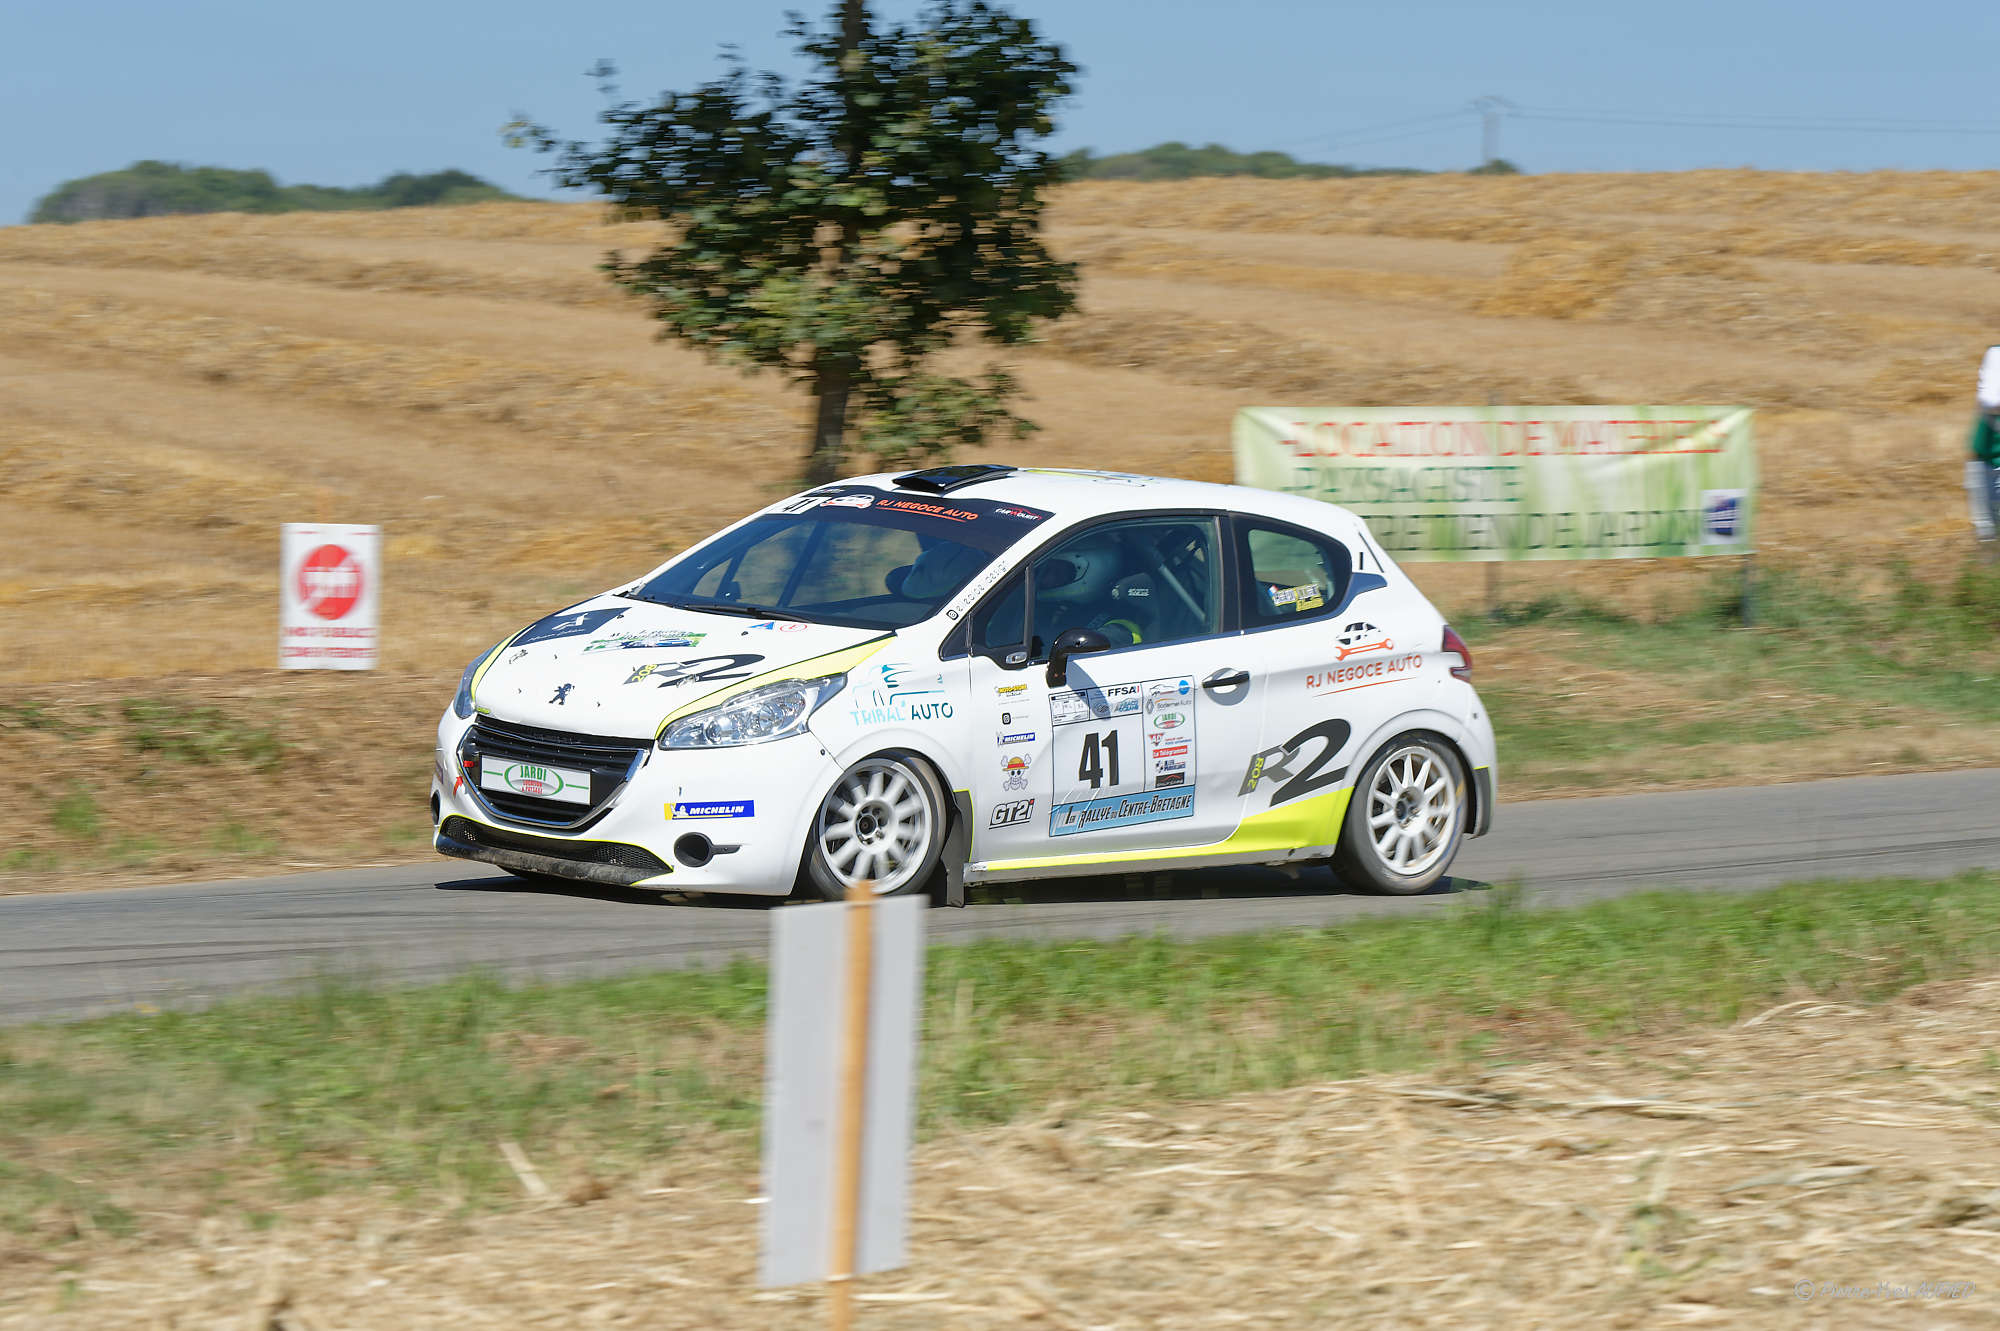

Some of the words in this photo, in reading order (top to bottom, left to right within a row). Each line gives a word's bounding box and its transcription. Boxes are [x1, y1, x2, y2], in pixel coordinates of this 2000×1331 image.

[876, 499, 893, 509] RJ
[892, 500, 944, 514] NEGOCE
[945, 507, 979, 521] AUTO
[631, 663, 659, 683] 208
[1305, 674, 1323, 690] RJ
[1326, 661, 1383, 685] NEGOCE
[1387, 654, 1423, 674] AUTO
[1107, 686, 1137, 698] FFSA
[911, 702, 954, 721] AUTO
[1004, 733, 1034, 743] MICHELIN
[1078, 729, 1120, 790] 41
[519, 765, 547, 782] JARDI
[1247, 756, 1265, 791] 208
[689, 805, 745, 815] MICHELIN
[990, 798, 1035, 826] GT2i
[1078, 806, 1112, 828] RALLYE
[1118, 795, 1193, 818] CENTRE-BRETAGNE
